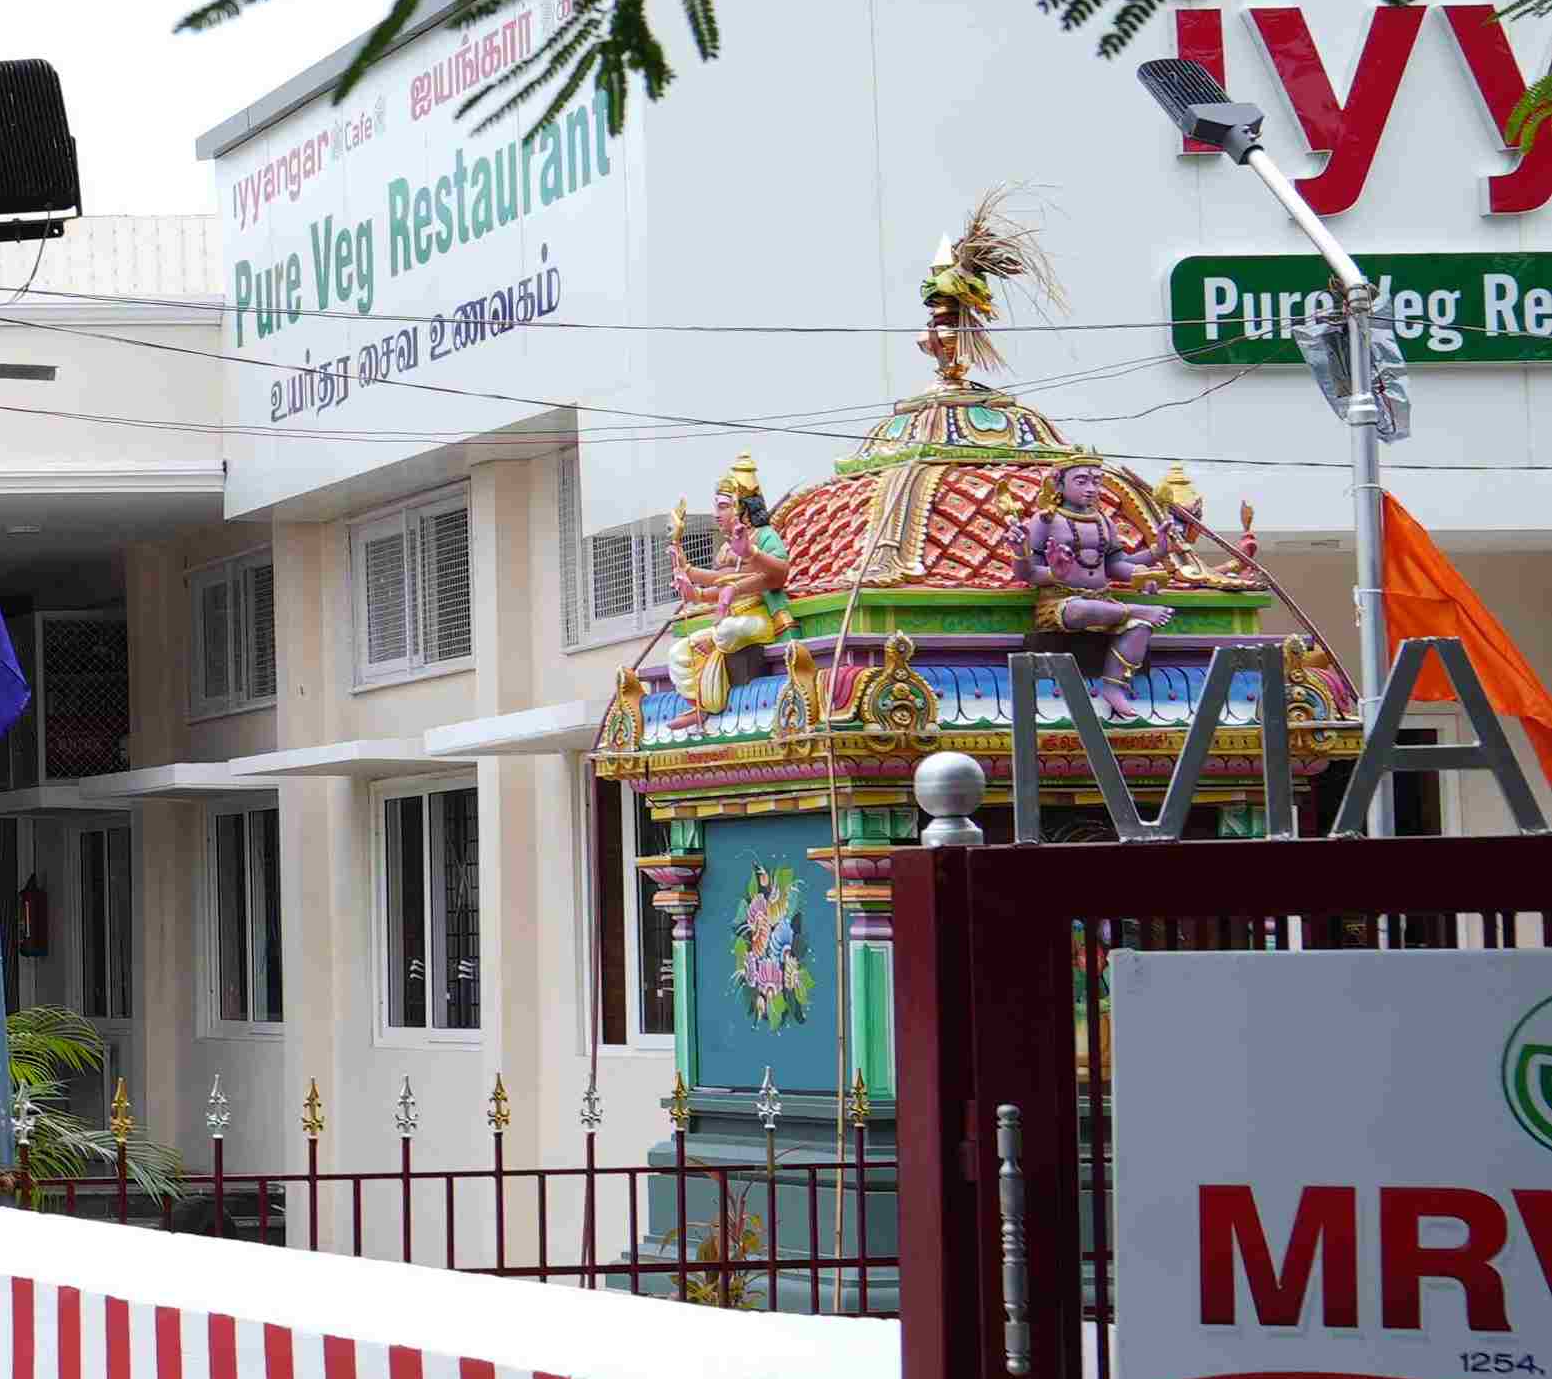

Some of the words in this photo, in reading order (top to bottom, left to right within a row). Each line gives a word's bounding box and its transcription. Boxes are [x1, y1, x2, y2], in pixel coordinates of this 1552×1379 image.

[234, 251, 302, 349] Pure
[308, 213, 375, 317] Veg
[387, 85, 612, 278] Restaurant
[344, 113, 373, 152] Cafe
[269, 349, 351, 422] உயர்தர
[357, 324, 419, 389] சைவ
[428, 242, 562, 362] உணவகம்
